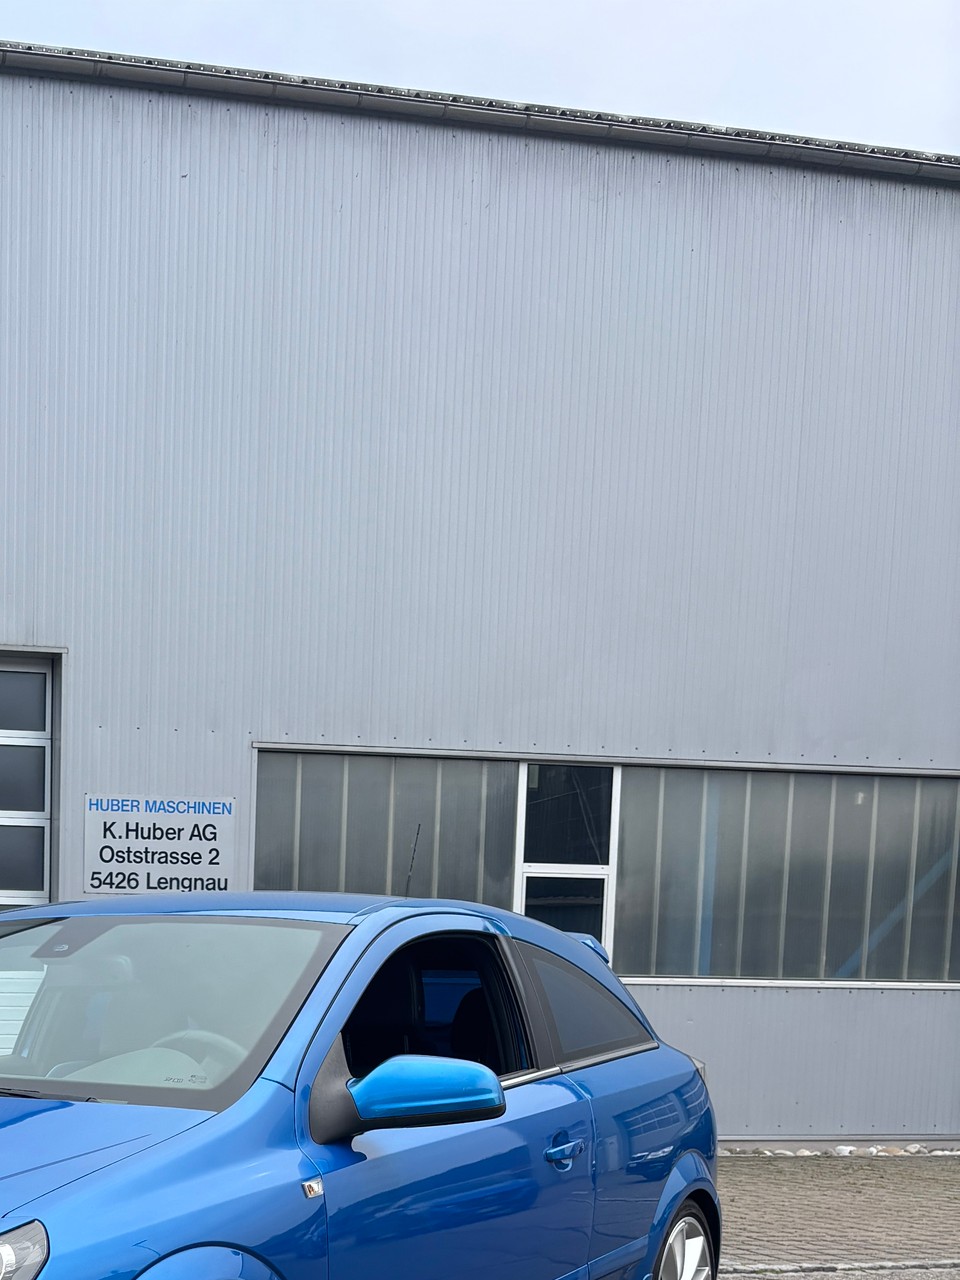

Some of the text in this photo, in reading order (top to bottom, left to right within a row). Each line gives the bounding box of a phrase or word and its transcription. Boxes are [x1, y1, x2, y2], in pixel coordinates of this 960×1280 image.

[89, 798, 232, 815] HUBER MASCHINEN
[189, 823, 217, 842] AG
[99, 845, 220, 865] Oststrasse 2
[90, 871, 228, 892] 5426 Lengnau
